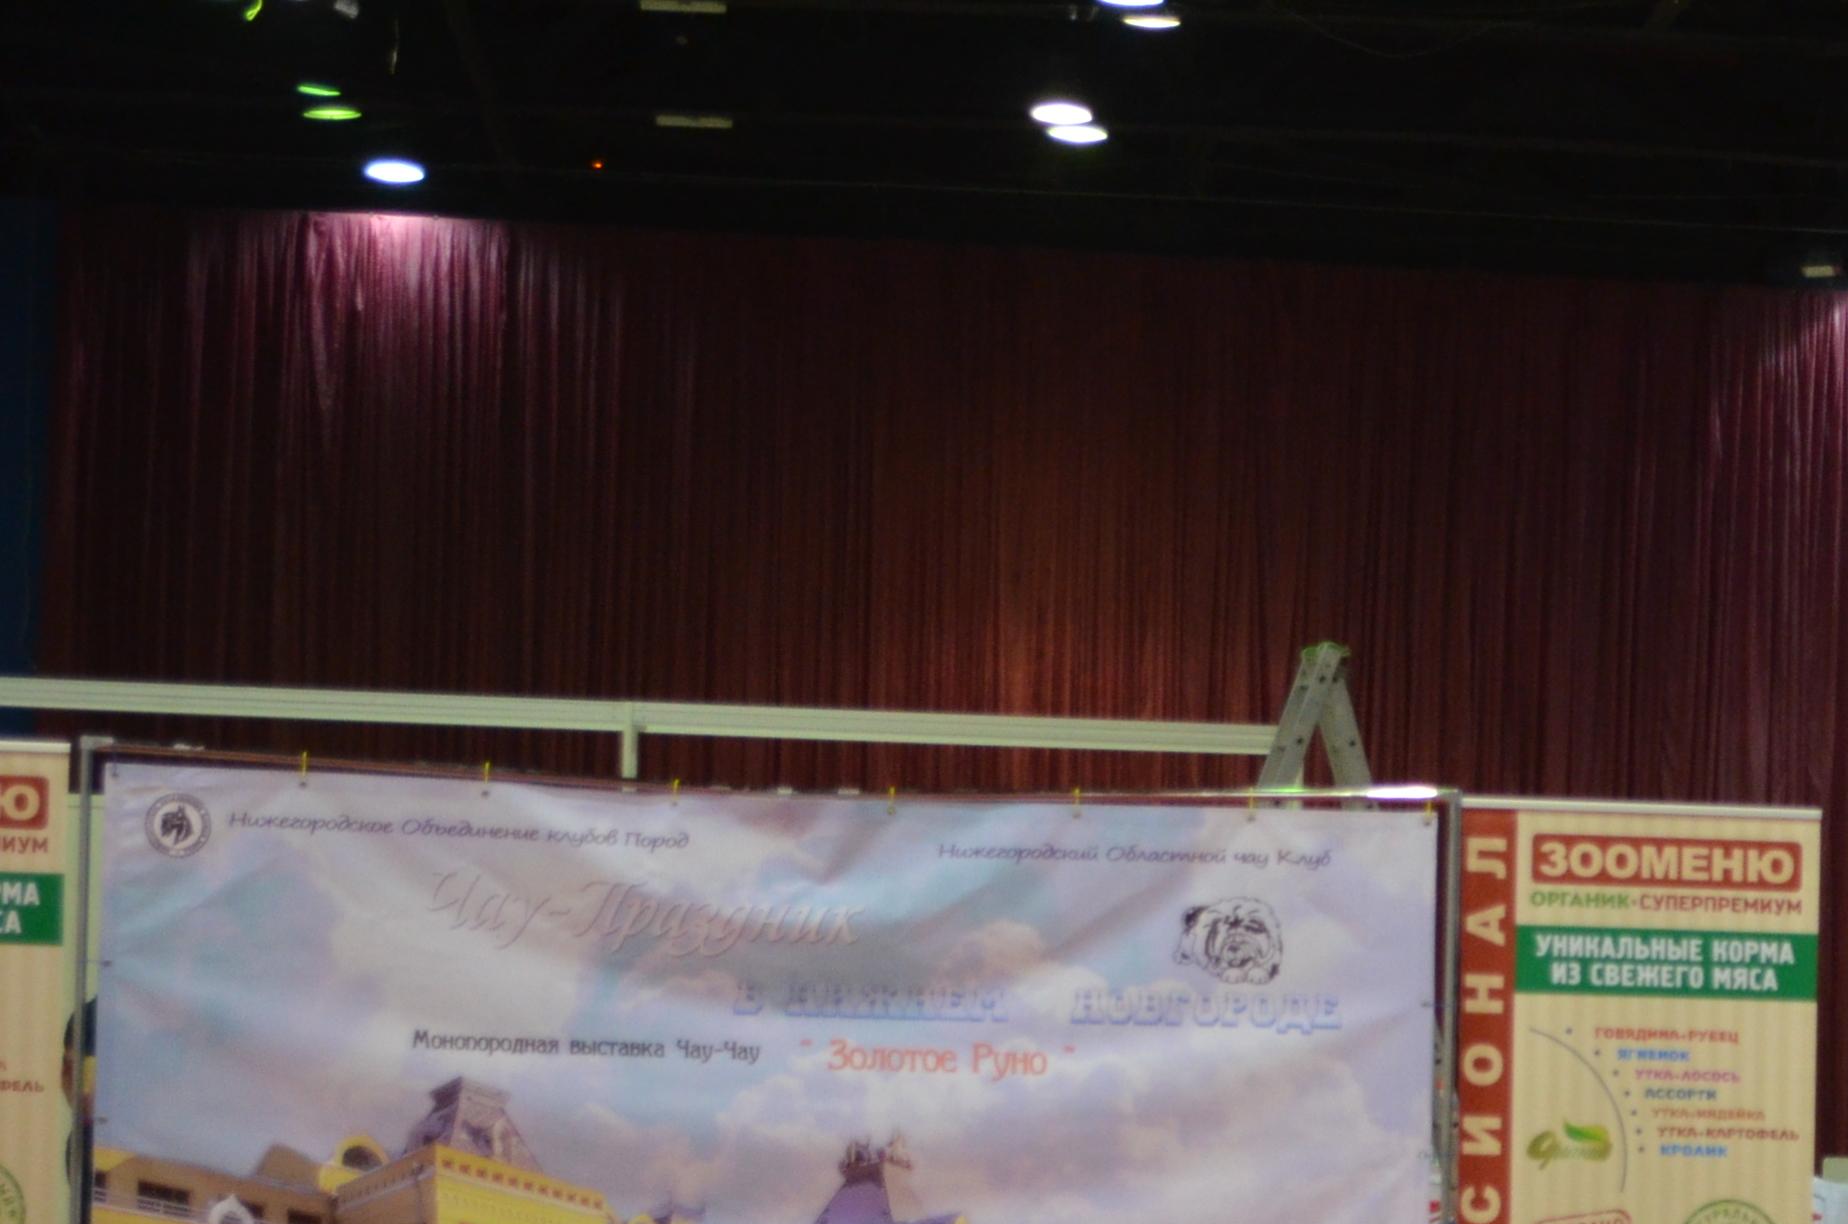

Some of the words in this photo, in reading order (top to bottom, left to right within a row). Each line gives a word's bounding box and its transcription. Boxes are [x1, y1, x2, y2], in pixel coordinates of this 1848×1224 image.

[227, 811, 395, 835] Нижегородское
[401, 816, 540, 843] Объединение
[547, 827, 620, 849] клубов
[625, 831, 691, 853] Пород
[1105, 844, 1227, 865] Областной
[1539, 840, 1796, 885] ЗООМЕНЮ
[1534, 933, 1703, 962] УНИКАЛЬНЫЕ
[1712, 938, 1796, 965] КОРМА
[1551, 961, 1582, 986] ИЗ
[1590, 963, 1704, 989] СВЕЖЕГО
[1712, 967, 1780, 992] МЯСА
[411, 1029, 560, 1057] Монопородная
[568, 1040, 665, 1059] выставка
[675, 1039, 762, 1066] Чау-Чау
[826, 1039, 958, 1074] Золотое
[970, 1042, 1049, 1082] Руно
